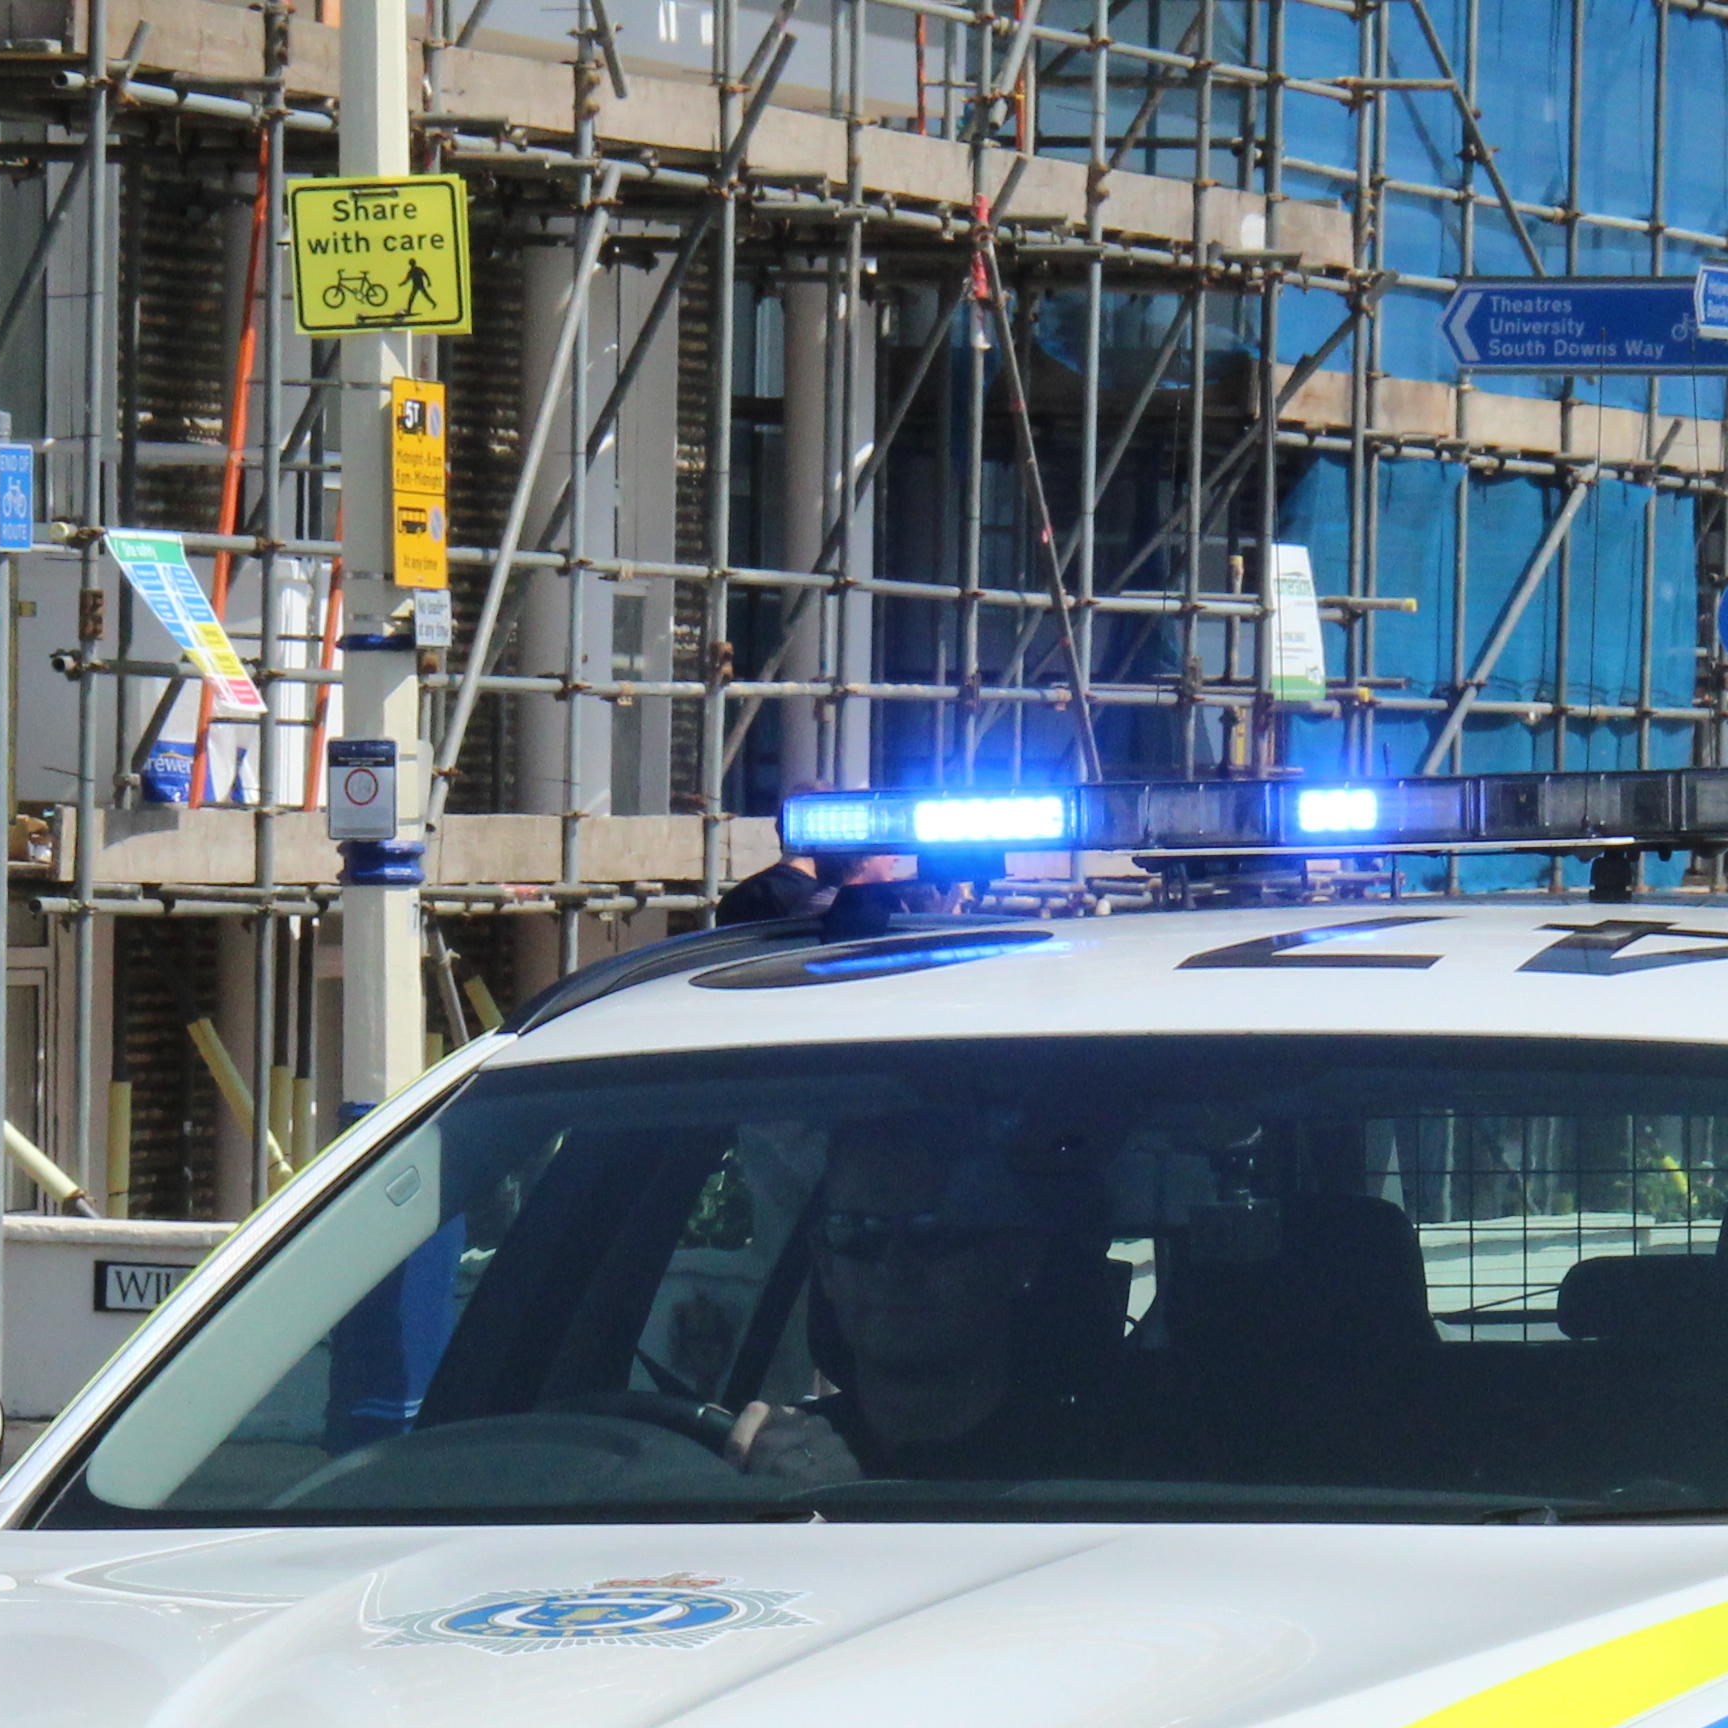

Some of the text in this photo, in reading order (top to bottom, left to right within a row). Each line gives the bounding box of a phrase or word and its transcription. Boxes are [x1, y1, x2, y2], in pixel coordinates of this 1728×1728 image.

[333, 198, 417, 222] Share
[307, 231, 444, 254] with care
[1490, 296, 1572, 313] Theatres
[1489, 318, 1584, 337] University
[1488, 339, 1664, 359] South Downs Way
[0, 454, 17, 472] END
[144, 756, 194, 774] rewer
